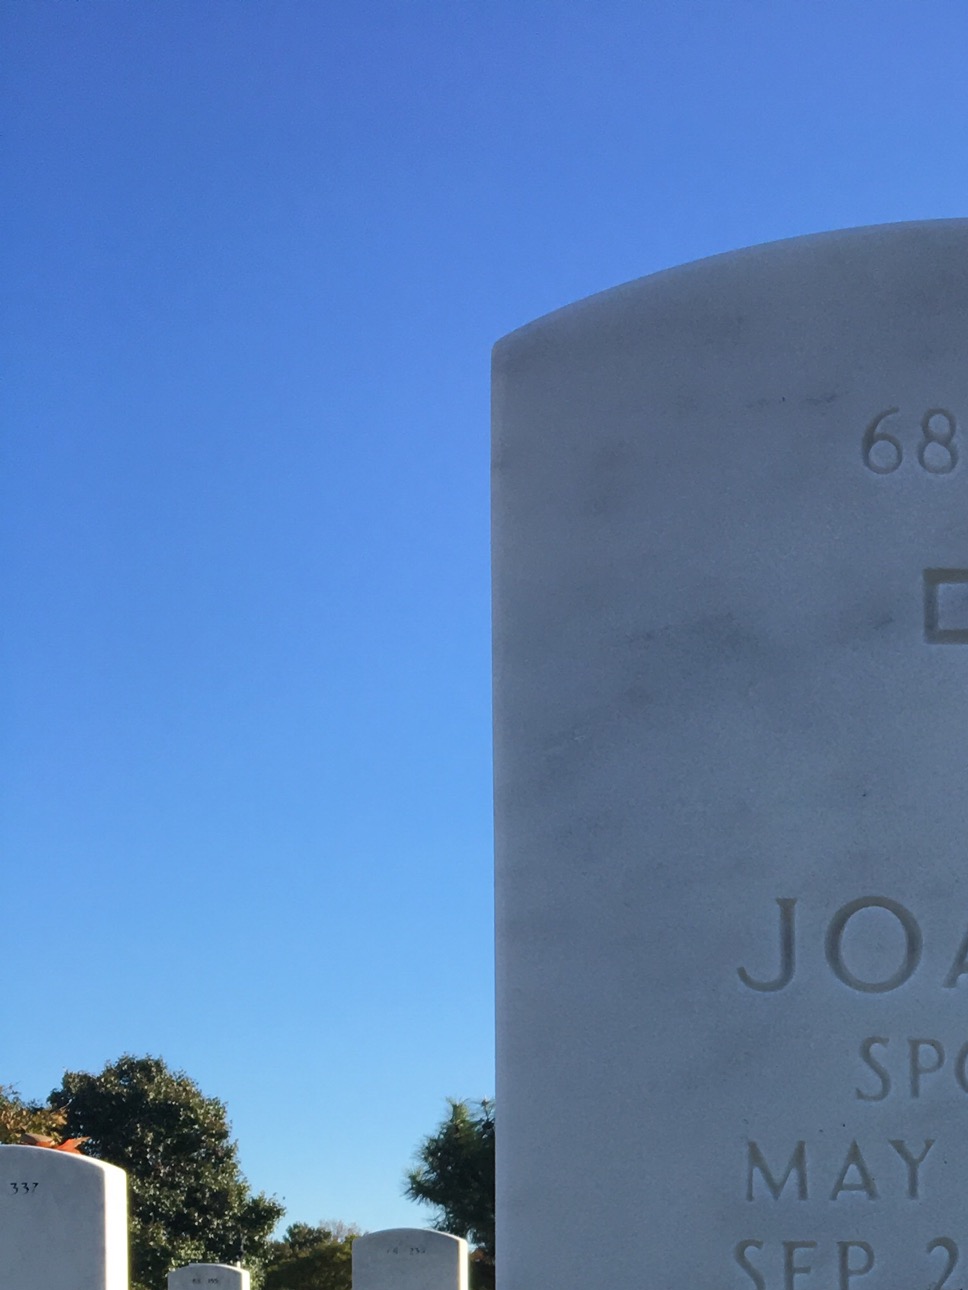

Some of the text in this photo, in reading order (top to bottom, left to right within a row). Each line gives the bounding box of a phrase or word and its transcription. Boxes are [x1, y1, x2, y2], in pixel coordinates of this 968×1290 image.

[861, 406, 959, 475] 68
[9, 1181, 40, 1196] 337
[746, 1138, 936, 1201] MAY
